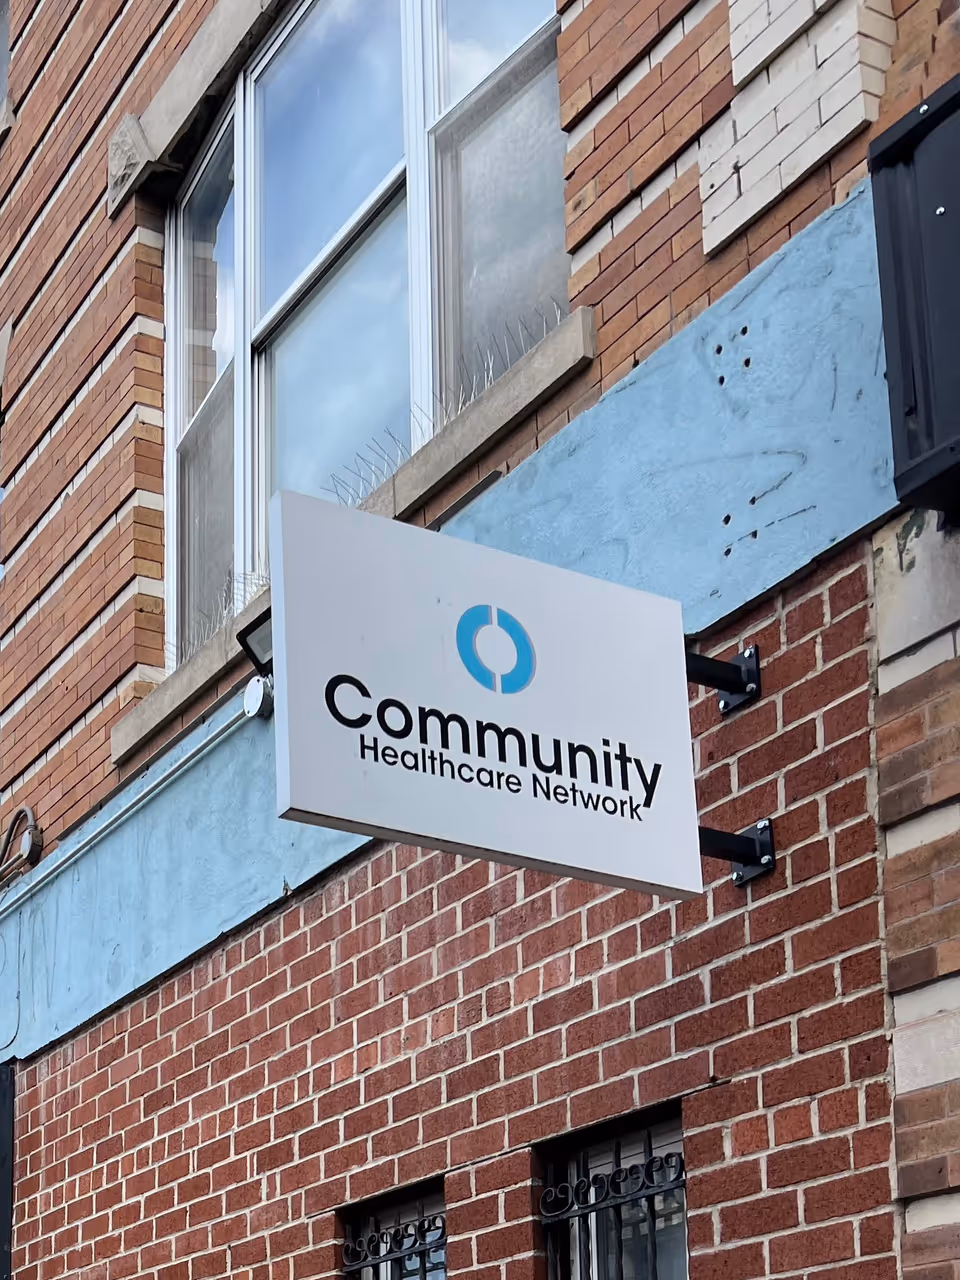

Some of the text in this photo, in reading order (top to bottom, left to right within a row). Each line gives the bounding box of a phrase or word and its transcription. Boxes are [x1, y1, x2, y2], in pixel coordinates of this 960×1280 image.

[325, 674, 662, 808] Community
[360, 734, 643, 821] Healthcare Network
